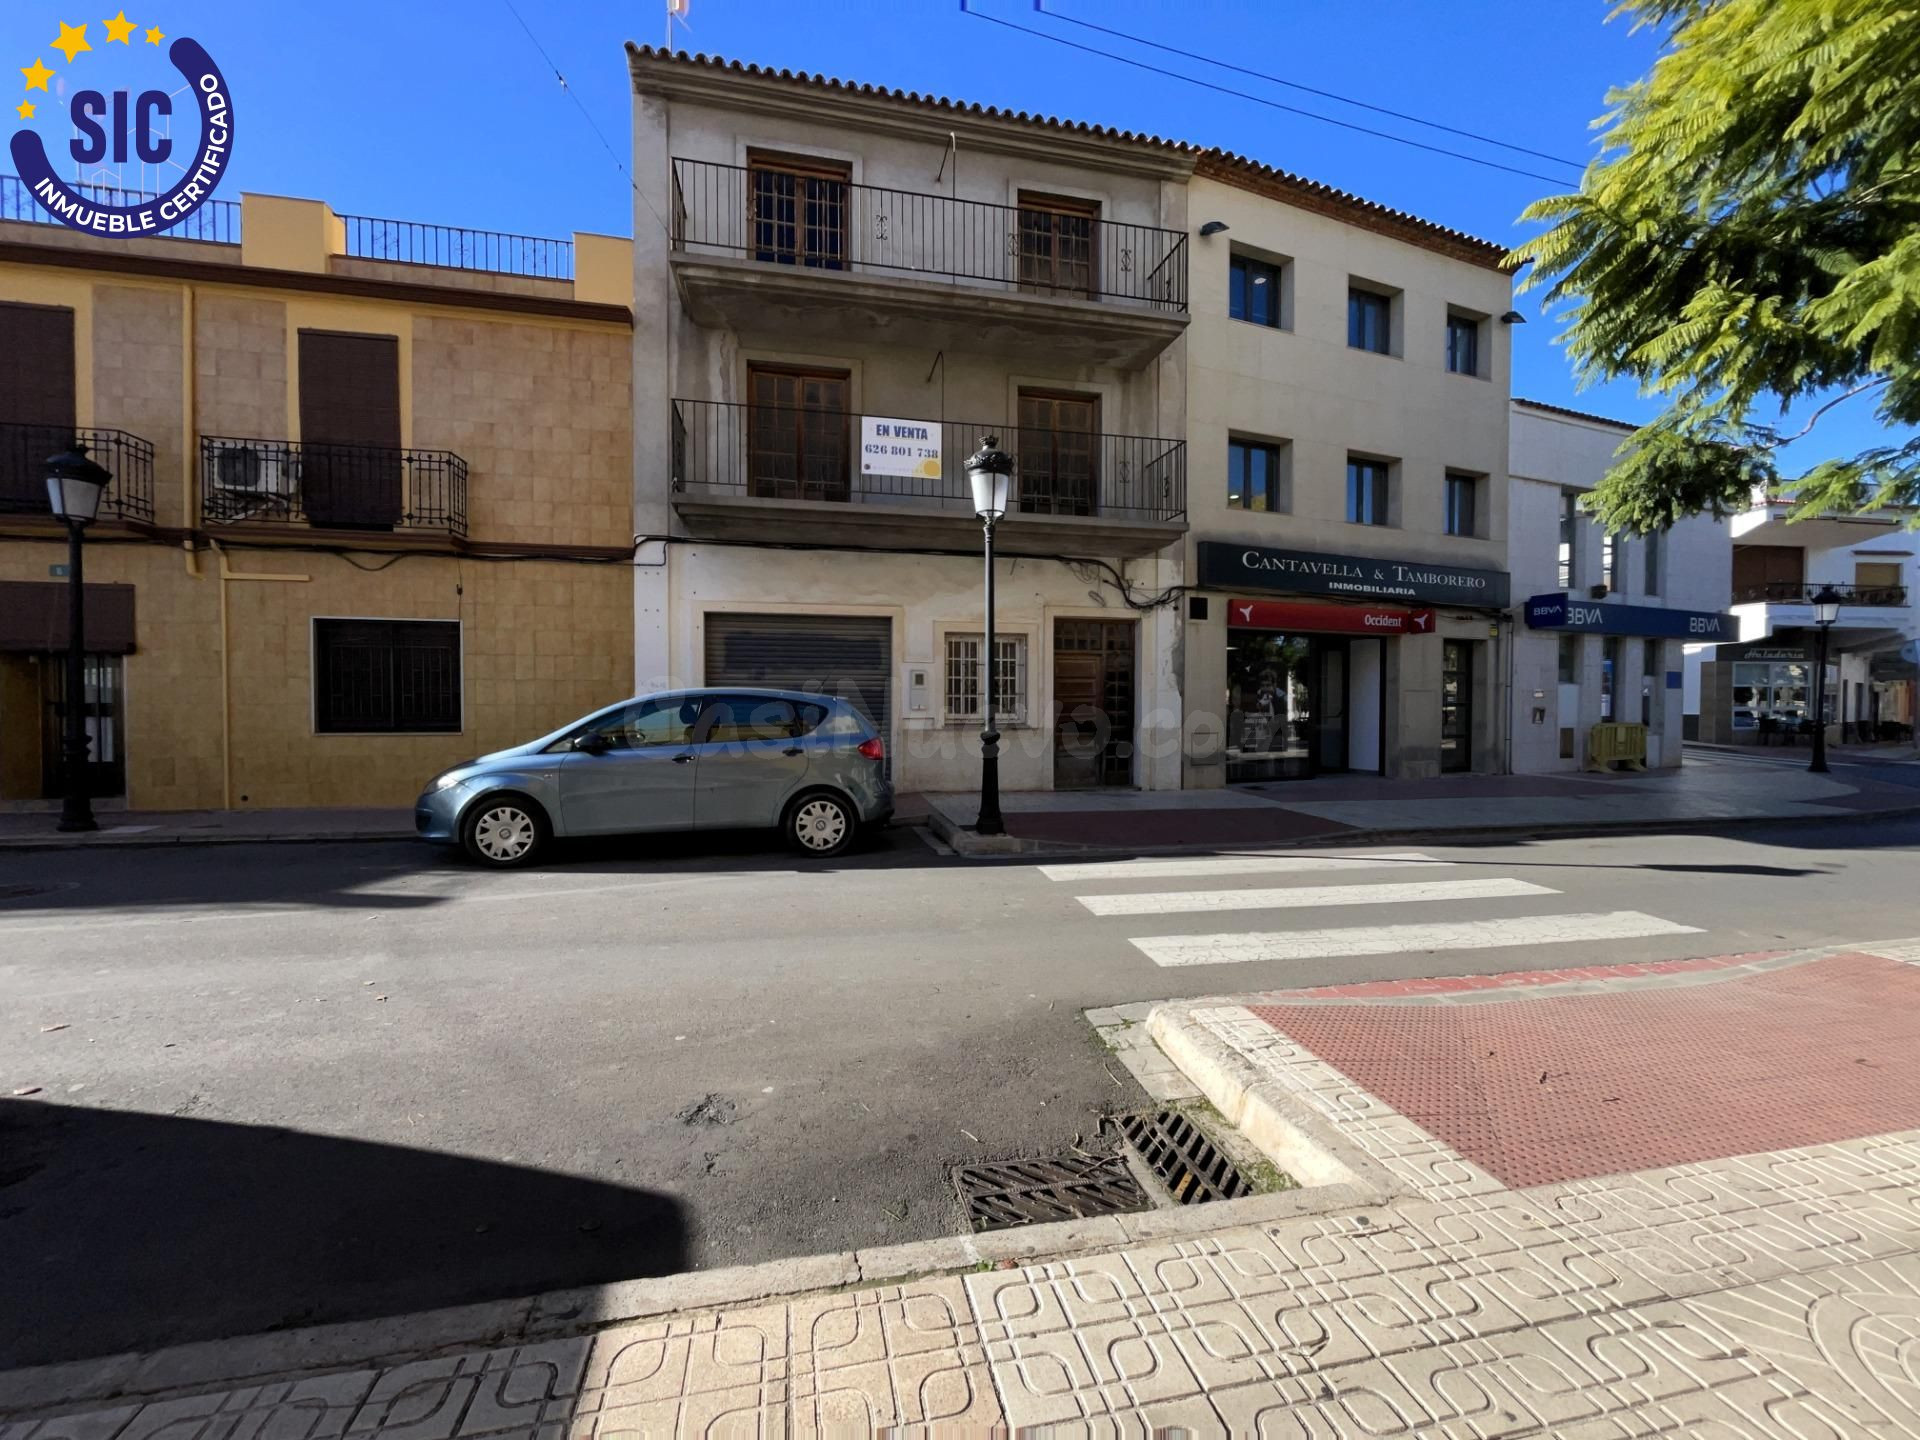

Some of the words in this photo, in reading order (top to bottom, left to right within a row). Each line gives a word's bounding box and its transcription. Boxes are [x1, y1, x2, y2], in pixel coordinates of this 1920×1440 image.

[876, 424, 890, 437] EN
[894, 425, 928, 440] VENTA
[864, 443, 888, 455] 626
[891, 445, 912, 457] 801
[917, 448, 939, 459] 738
[1242, 550, 1363, 578] CANTAVELLA
[1373, 568, 1384, 580] &
[1392, 565, 1486, 588] TAMBORERO
[1328, 581, 1416, 596] INMOBILIARIA
[1533, 604, 1563, 616] BBVA
[1364, 613, 1402, 627] Occident
[1689, 616, 1721, 633] BBVA
